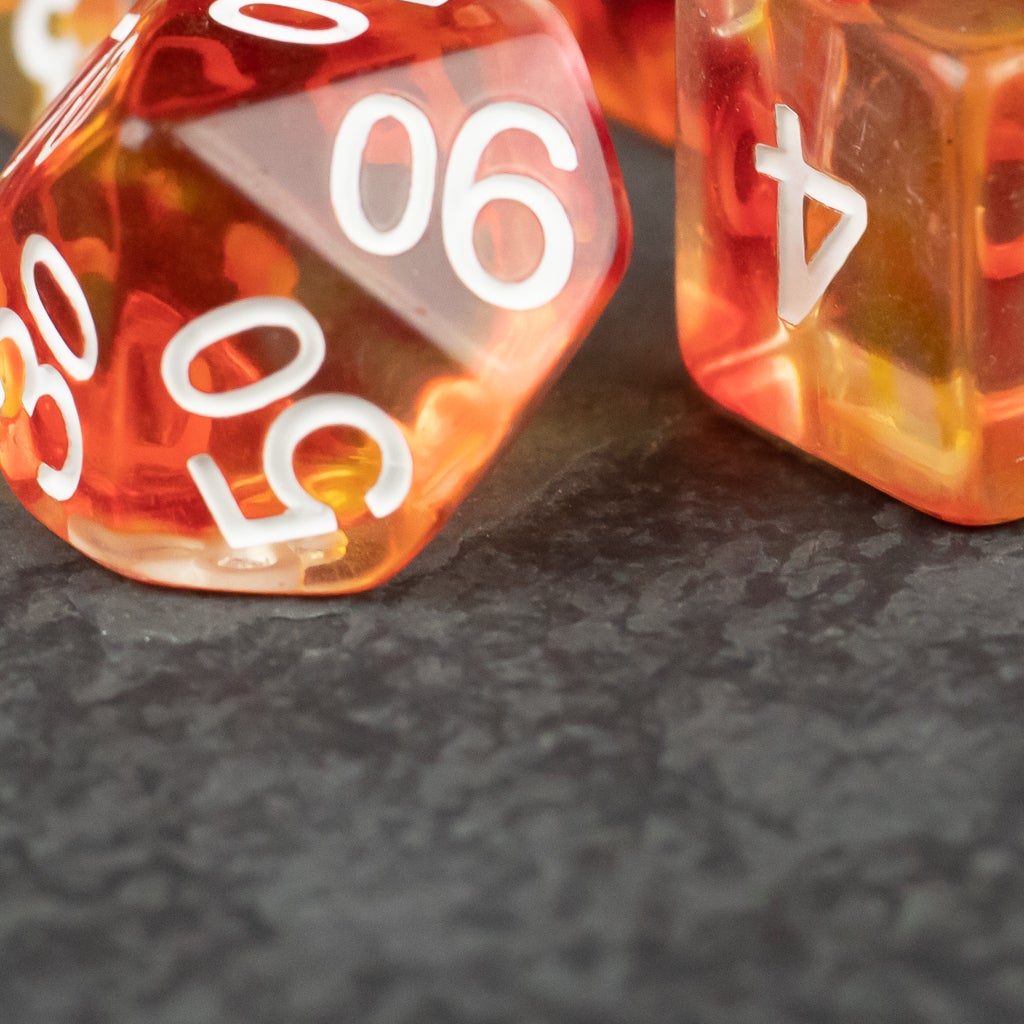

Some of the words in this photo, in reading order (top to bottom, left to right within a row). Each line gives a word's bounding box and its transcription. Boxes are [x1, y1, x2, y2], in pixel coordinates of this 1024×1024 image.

[755, 103, 868, 326] 4
[0, 233, 99, 502] 30
[160, 295, 413, 549] 50
